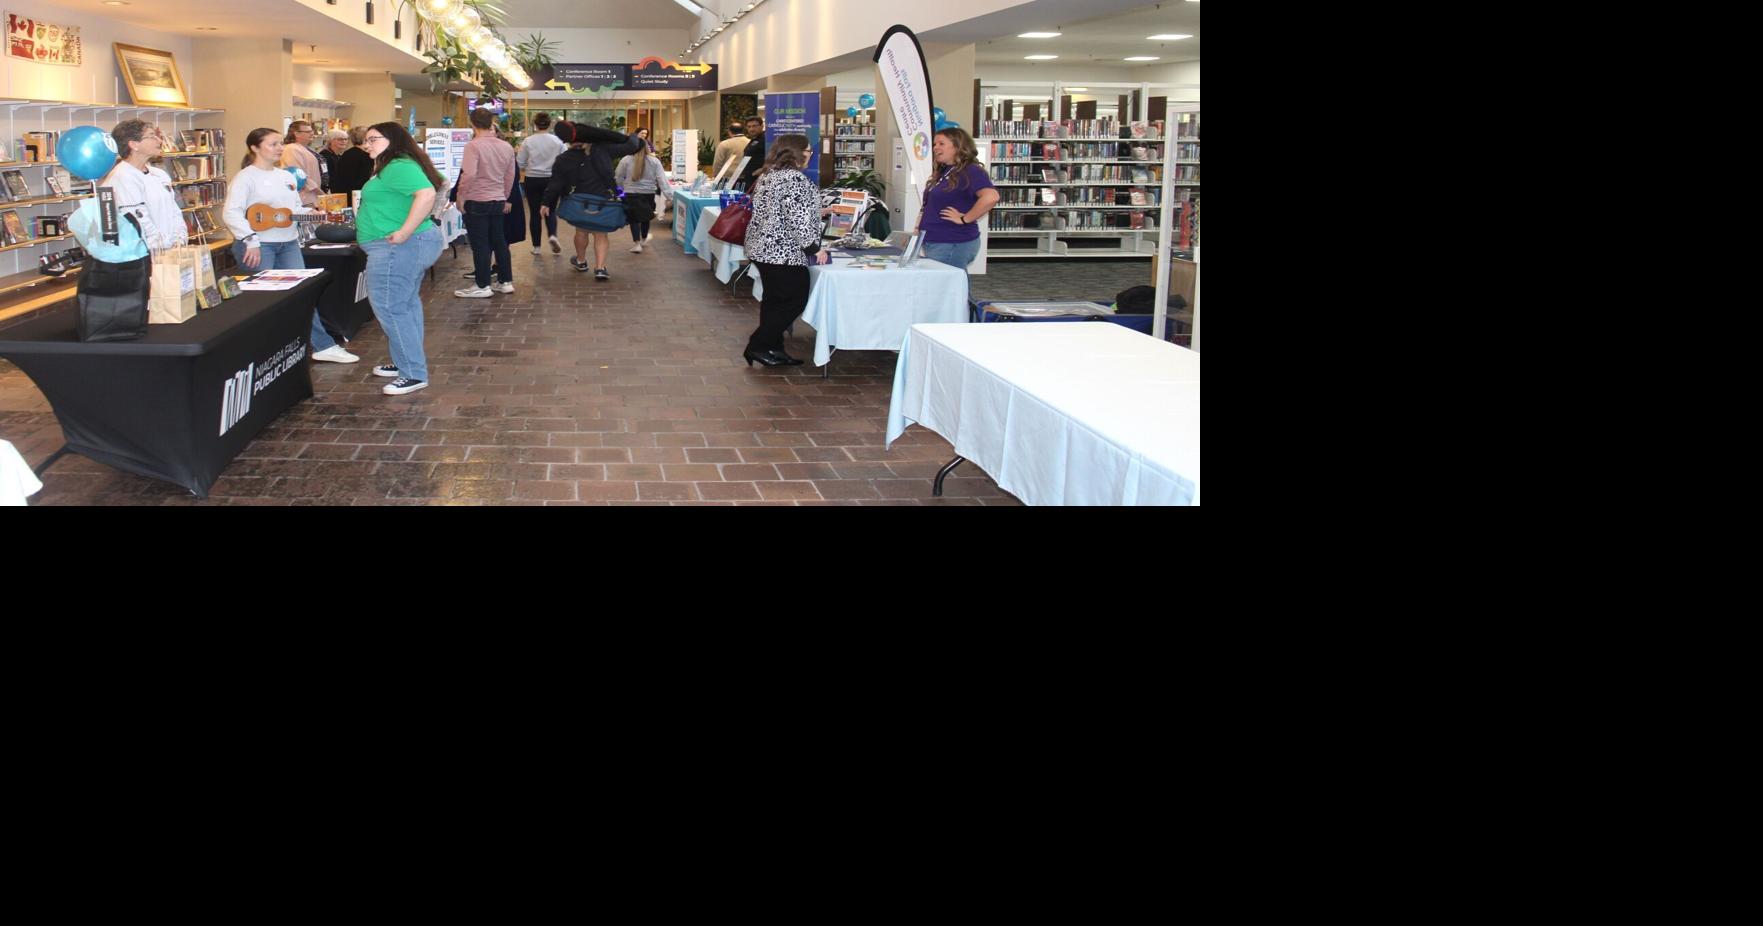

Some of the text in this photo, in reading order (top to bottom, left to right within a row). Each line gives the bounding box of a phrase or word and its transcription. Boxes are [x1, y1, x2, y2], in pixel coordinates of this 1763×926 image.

[253, 343, 306, 396] PUBLIC LIBRARY
[255, 336, 301, 379] NIAGARA FALLS
